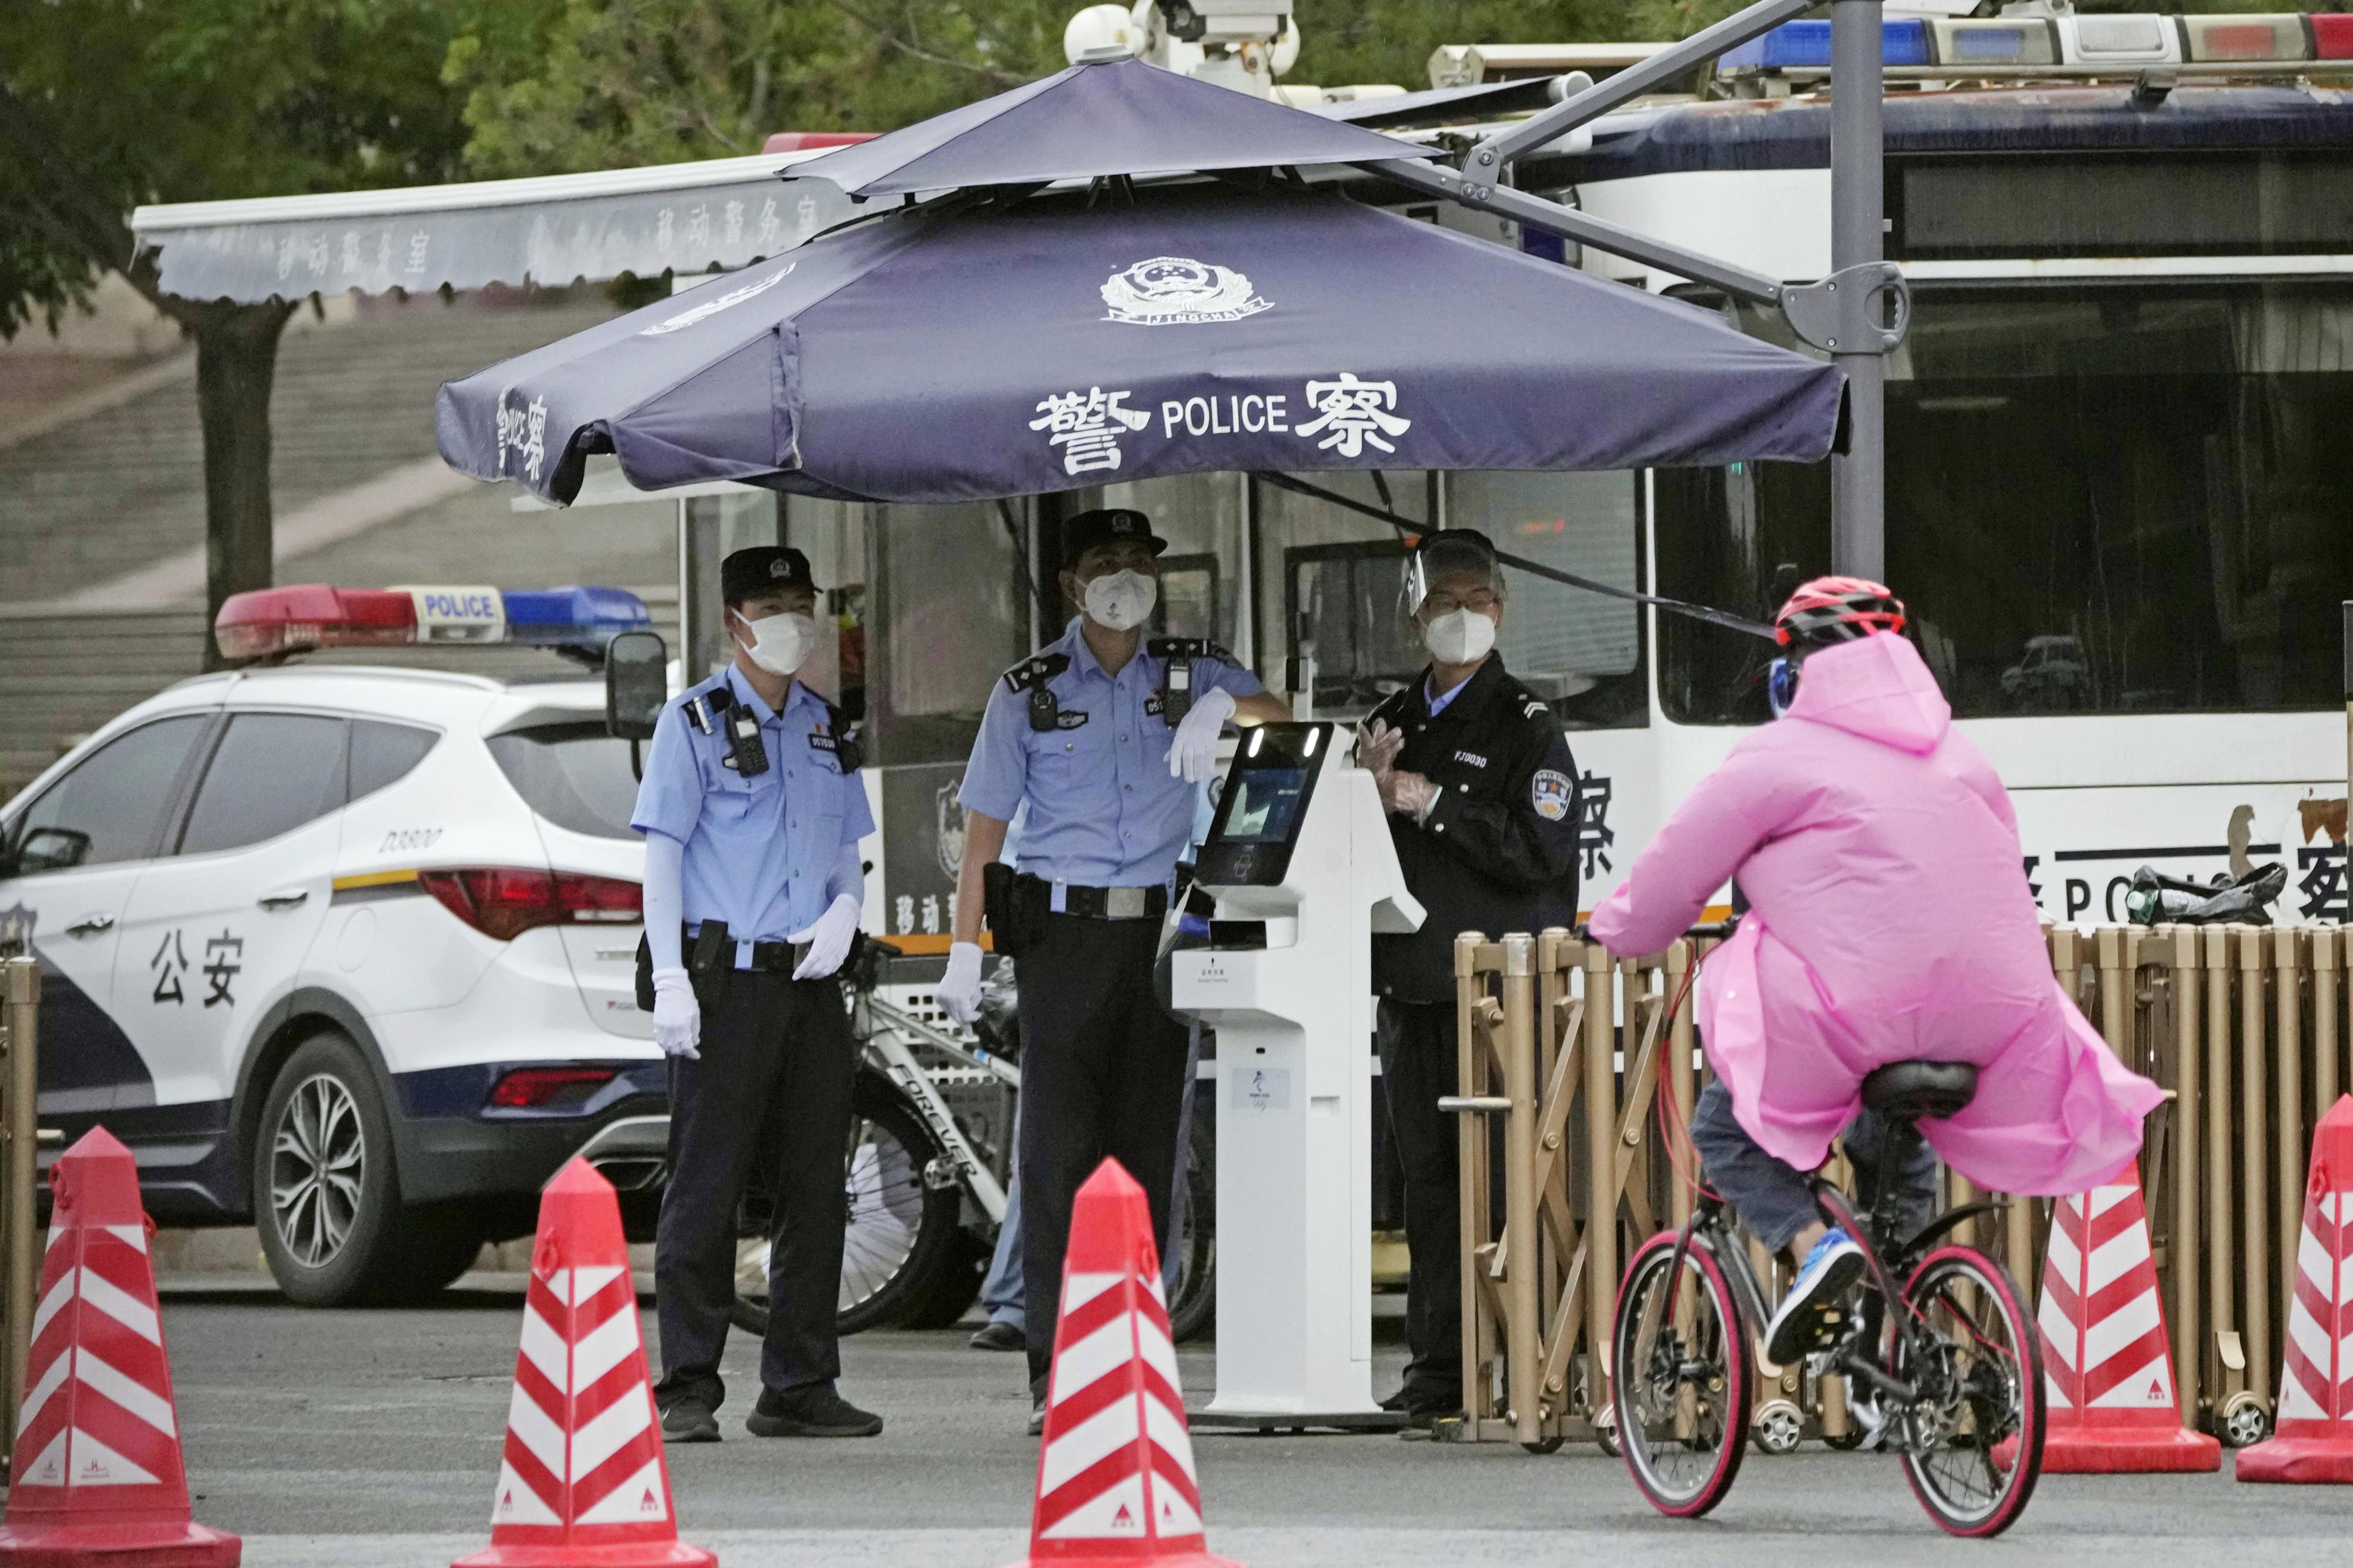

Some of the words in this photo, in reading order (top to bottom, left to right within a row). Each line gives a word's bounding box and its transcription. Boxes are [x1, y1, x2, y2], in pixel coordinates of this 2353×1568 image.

[523, 394, 548, 482] 察
[1029, 386, 1151, 475] 警
[1161, 394, 1289, 439] POLICE
[1295, 372, 1412, 458] 察
[424, 595, 495, 617] POLICE
[151, 928, 244, 1008] 公安
[895, 1064, 977, 1176] FOREVER
